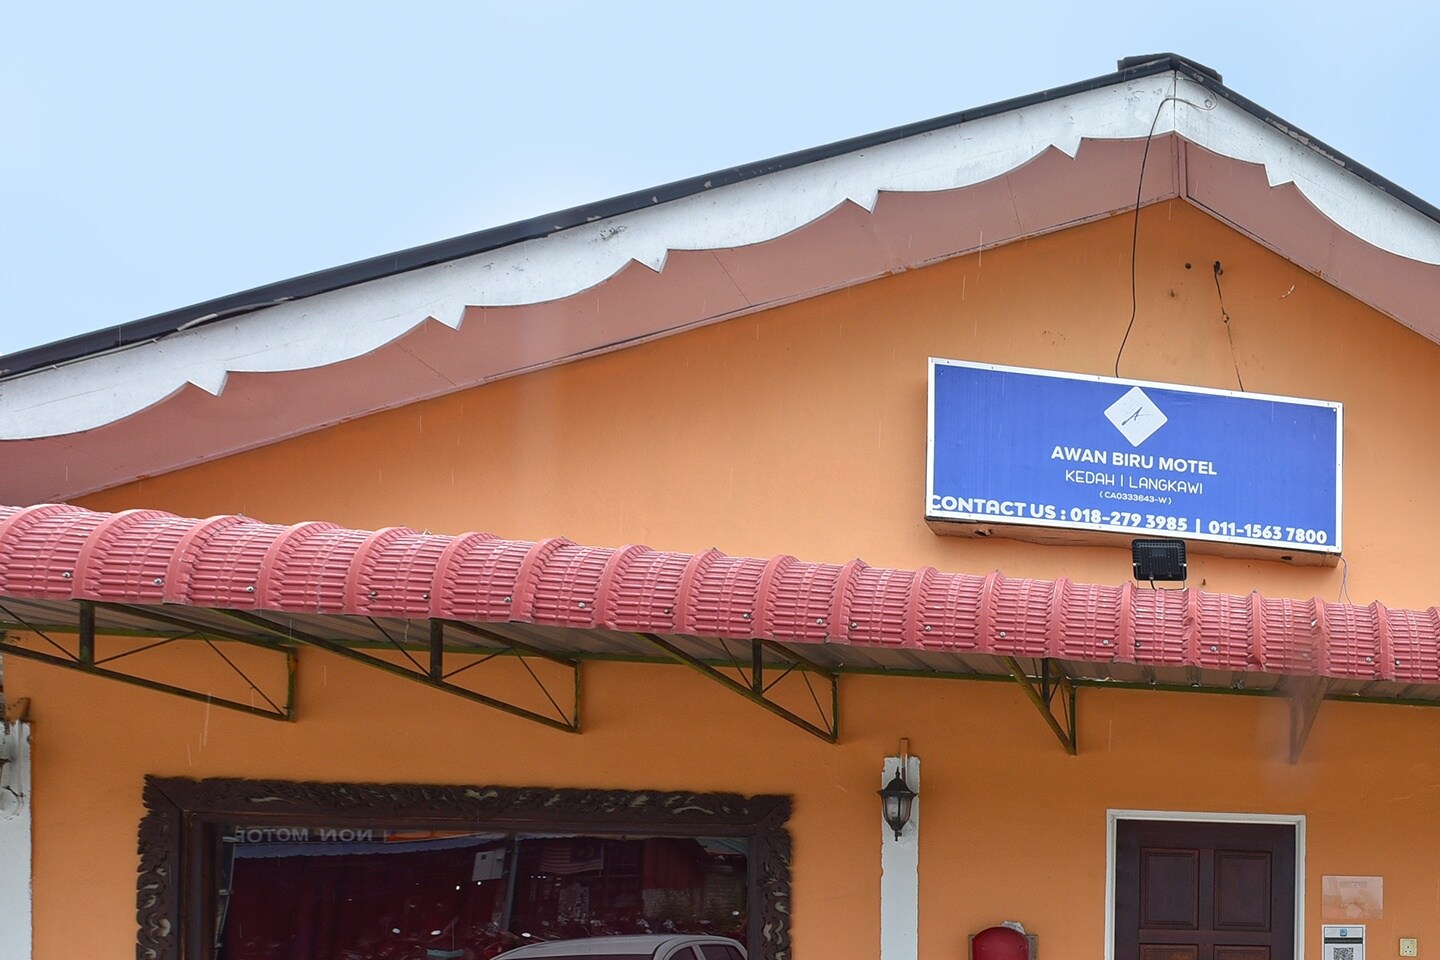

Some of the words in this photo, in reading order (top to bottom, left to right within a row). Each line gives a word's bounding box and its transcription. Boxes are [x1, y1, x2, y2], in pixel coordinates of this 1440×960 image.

[1051, 445, 1107, 465] AWAN
[1112, 452, 1154, 469] BIRU
[1158, 457, 1217, 476] MOTEL
[1065, 469, 1115, 486] KEDAH
[1129, 476, 1203, 494] LANGKAWI
[931, 495, 1026, 517] CONTACT
[1030, 503, 1057, 519] US
[1070, 507, 1141, 527] 018-279
[1146, 514, 1188, 531] 3985
[1208, 520, 1282, 540] 011-1563
[1285, 527, 1328, 544] 7800
